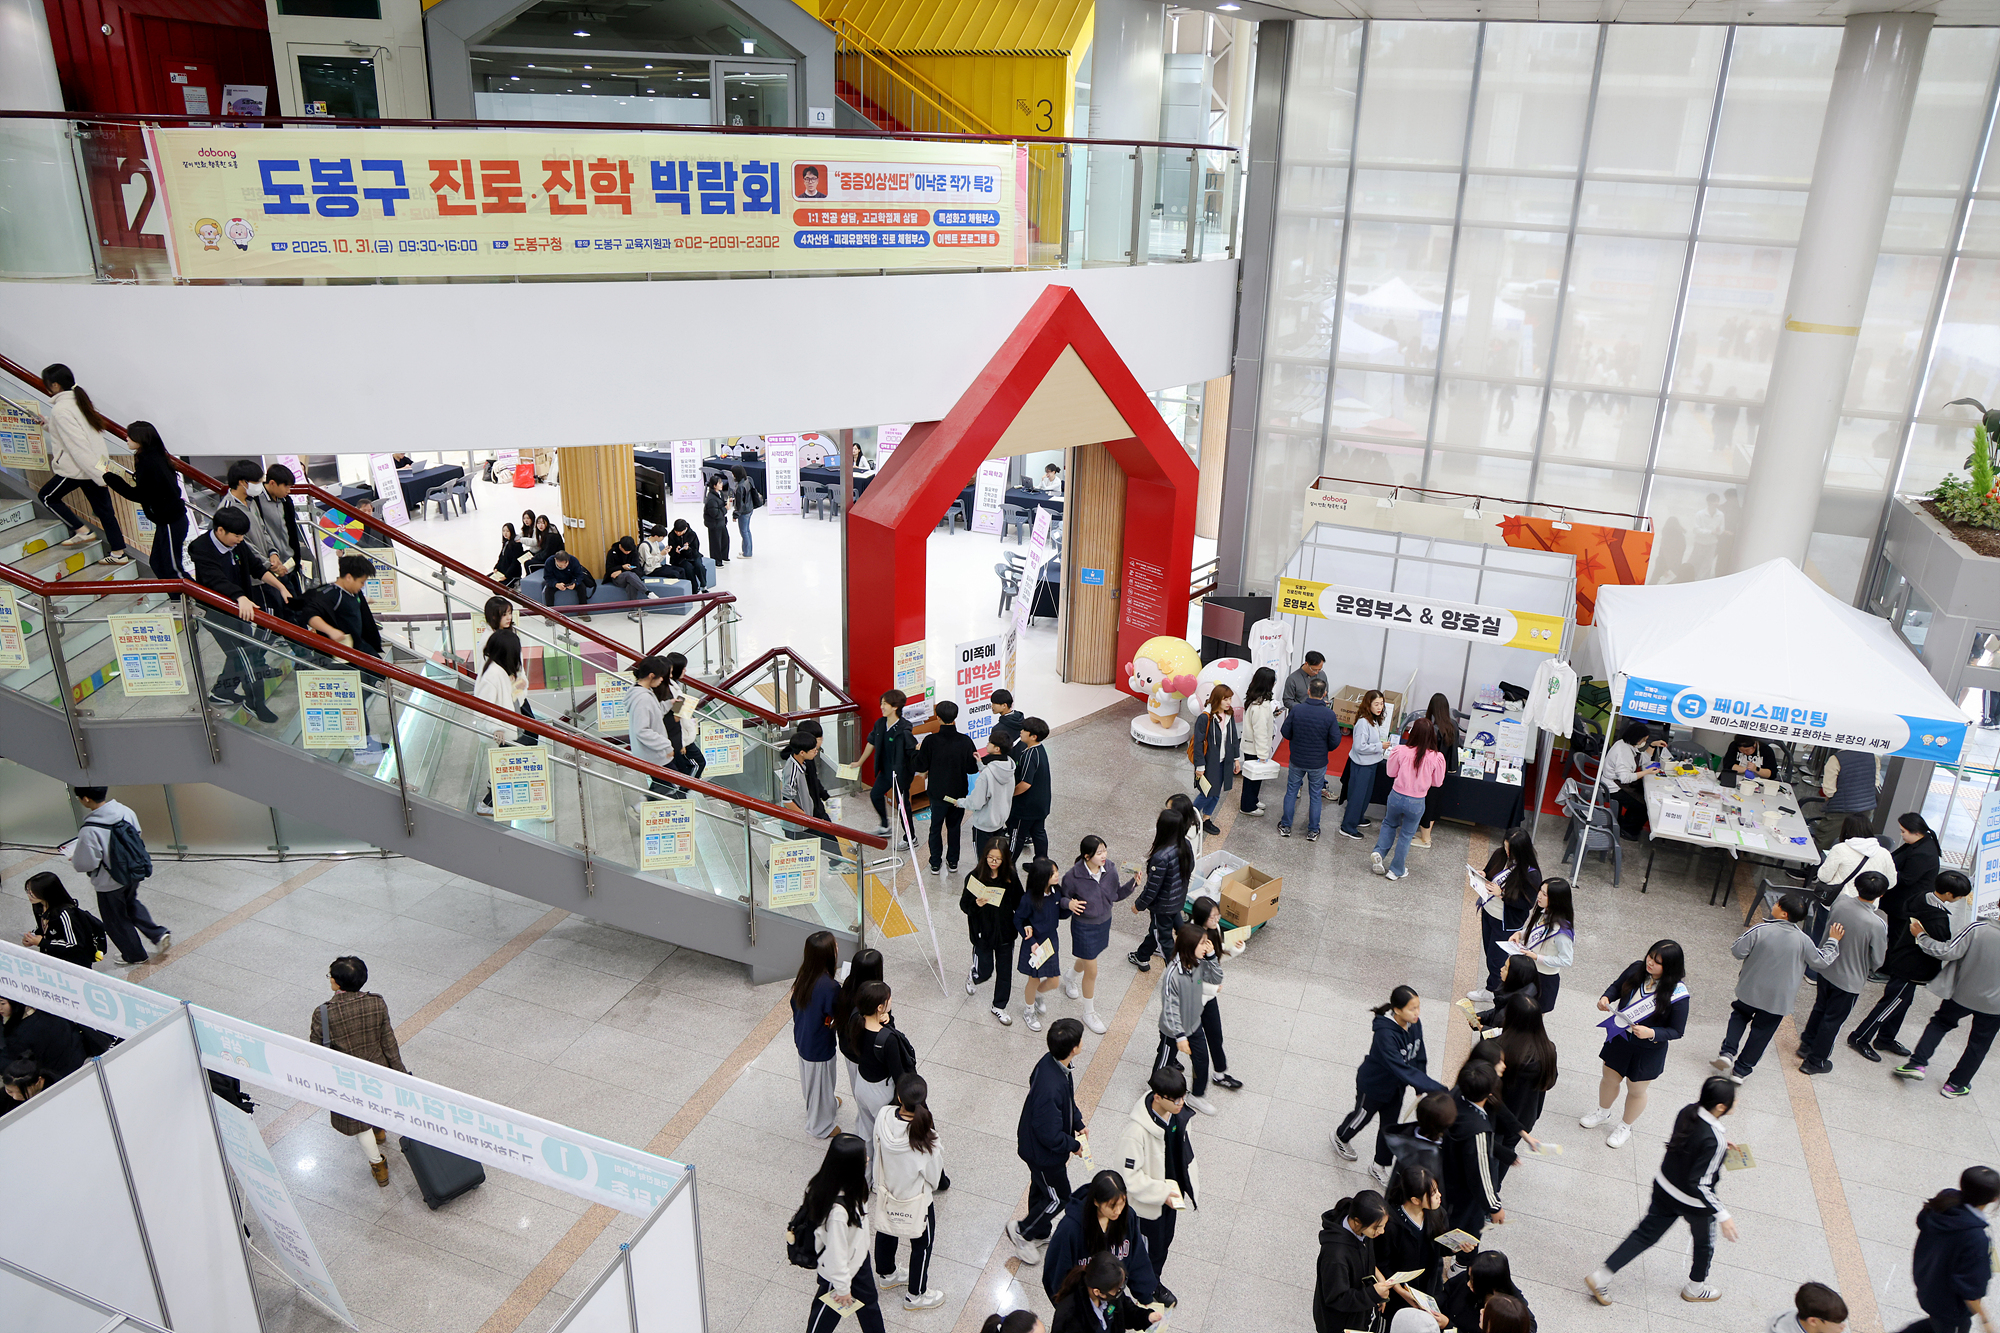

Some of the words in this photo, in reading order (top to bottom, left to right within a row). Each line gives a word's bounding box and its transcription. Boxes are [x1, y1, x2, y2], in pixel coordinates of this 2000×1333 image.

[1035, 99, 1053, 133] 3
[198, 148, 237, 159] dobong
[257, 158, 410, 217] 도봉구
[650, 160, 781, 215] 박람회
[950, 174, 970, 192] 작가
[973, 175, 993, 193] 특강
[808, 212, 819, 223] 1:1
[821, 212, 837, 224] 전공
[840, 212, 860, 225] 상담,
[862, 212, 900, 224] 고교학점제
[903, 212, 918, 224] 상담
[939, 213, 966, 224] 특성화고
[968, 213, 995, 225] 체험부스
[292, 241, 331, 254] 2025.
[332, 239, 353, 254] 10.
[399, 239, 478, 253] 09:30~16:00
[513, 237, 563, 252] 도봉구청
[594, 238, 622, 251] 도봉구
[624, 238, 671, 251] 교육지원과
[684, 236, 780, 249] 02-2091-2302
[898, 234, 925, 245] 체험부스
[937, 234, 958, 245] 이벤트
[960, 234, 986, 245] 프로그램
[988, 234, 995, 245] 등
[983, 469, 1003, 478] 교육학과
[1322, 495, 1347, 504] dobong
[1283, 597, 1315, 612] 운영부스
[1336, 594, 1413, 624] 운영부스
[1420, 607, 1433, 625] &
[1440, 608, 1501, 637] 양호실
[132, 626, 154, 634] 도봉구
[962, 643, 996, 663] 이쪽에
[957, 660, 1001, 686] 대학생
[304, 691, 333, 699] 진로진학
[335, 691, 356, 699] 박람회
[965, 683, 993, 705] 멘토
[1628, 701, 1666, 716] 이벤트존
[1684, 699, 1699, 715] 3
[1713, 697, 1828, 728] 페이스페인팅
[967, 715, 992, 731] 당신을
[1709, 715, 1789, 737] 페이스페인팅으로
[1791, 727, 1832, 742] 표현하는
[1835, 732, 1867, 746] 분장의
[1868, 737, 1891, 750] 세계
[509, 757, 529, 765] 도봉구
[523, 764, 543, 772] 박람회
[659, 810, 678, 818] 도봉구
[786, 849, 804, 857] 도봉구
